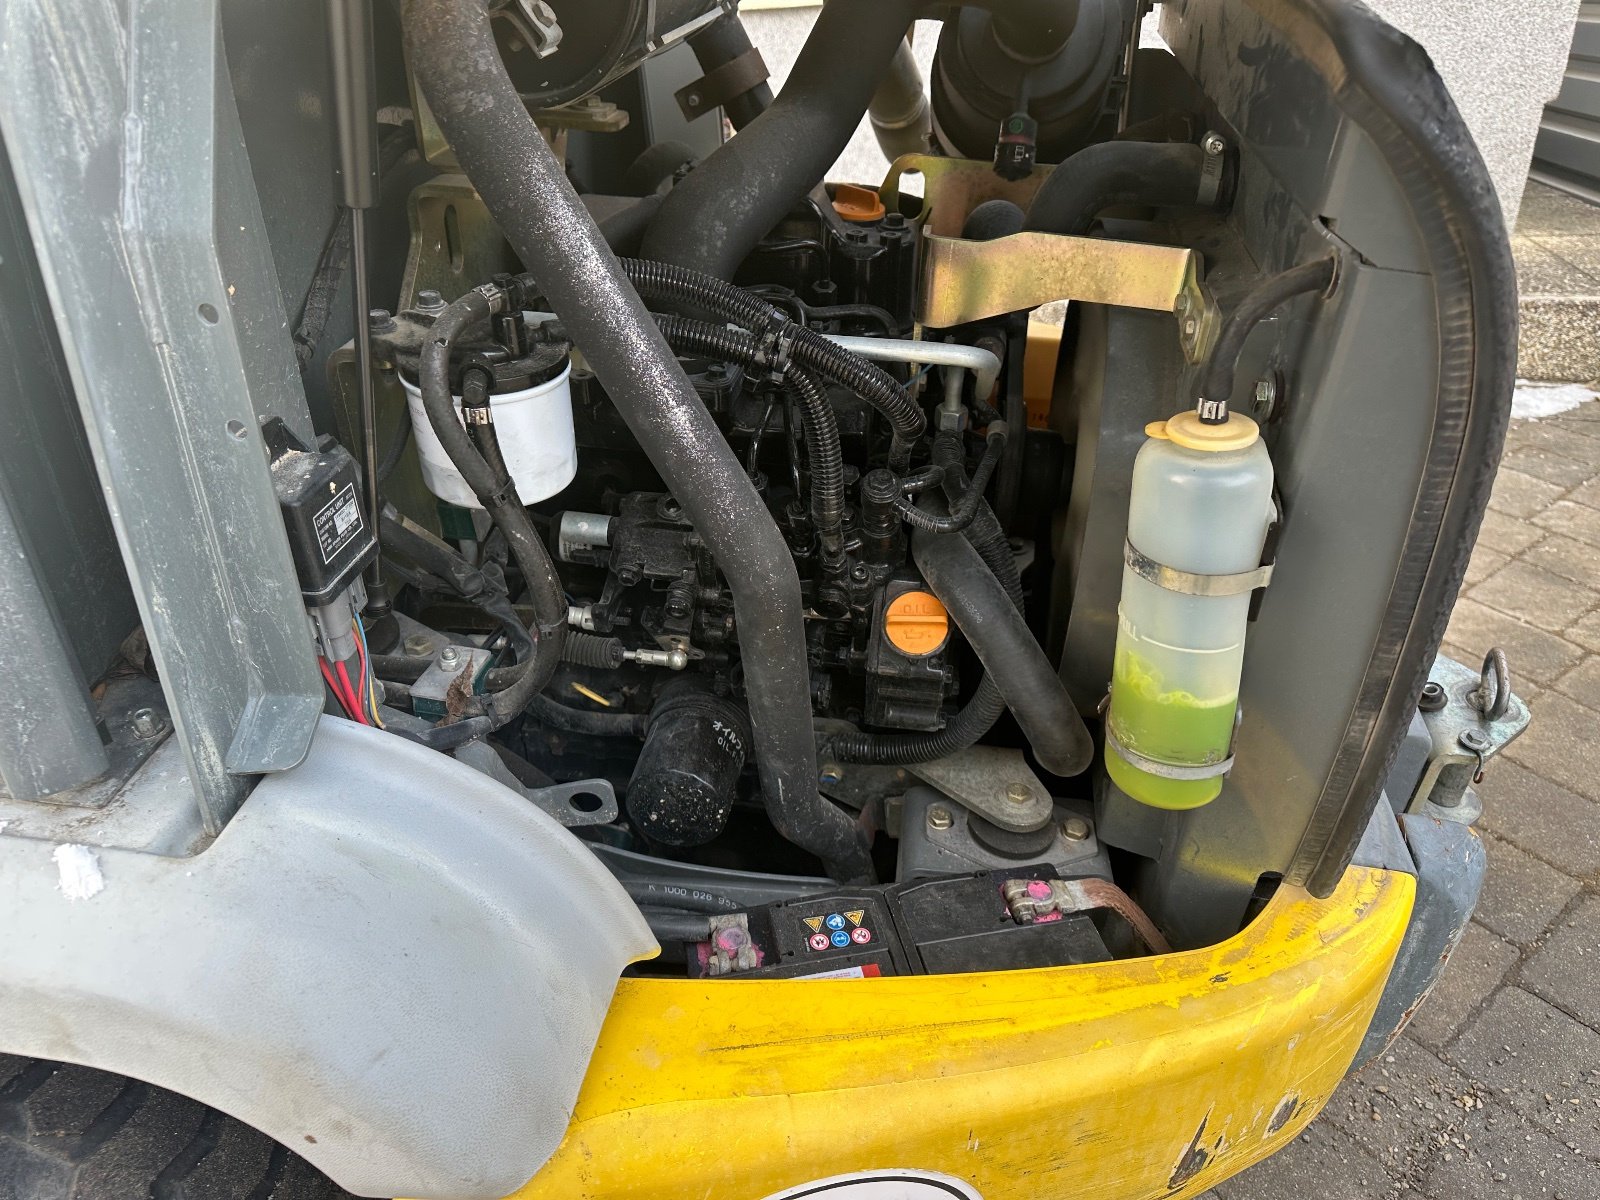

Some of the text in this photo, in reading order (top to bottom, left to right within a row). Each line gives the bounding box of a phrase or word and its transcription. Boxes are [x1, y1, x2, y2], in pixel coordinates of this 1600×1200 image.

[316, 506, 336, 527] CONTROL
[903, 604, 930, 614] OIL
[717, 736, 729, 752] OIL
[664, 885, 687, 897] 1000
[692, 890, 712, 901] 026
[718, 897, 737, 910] 955
